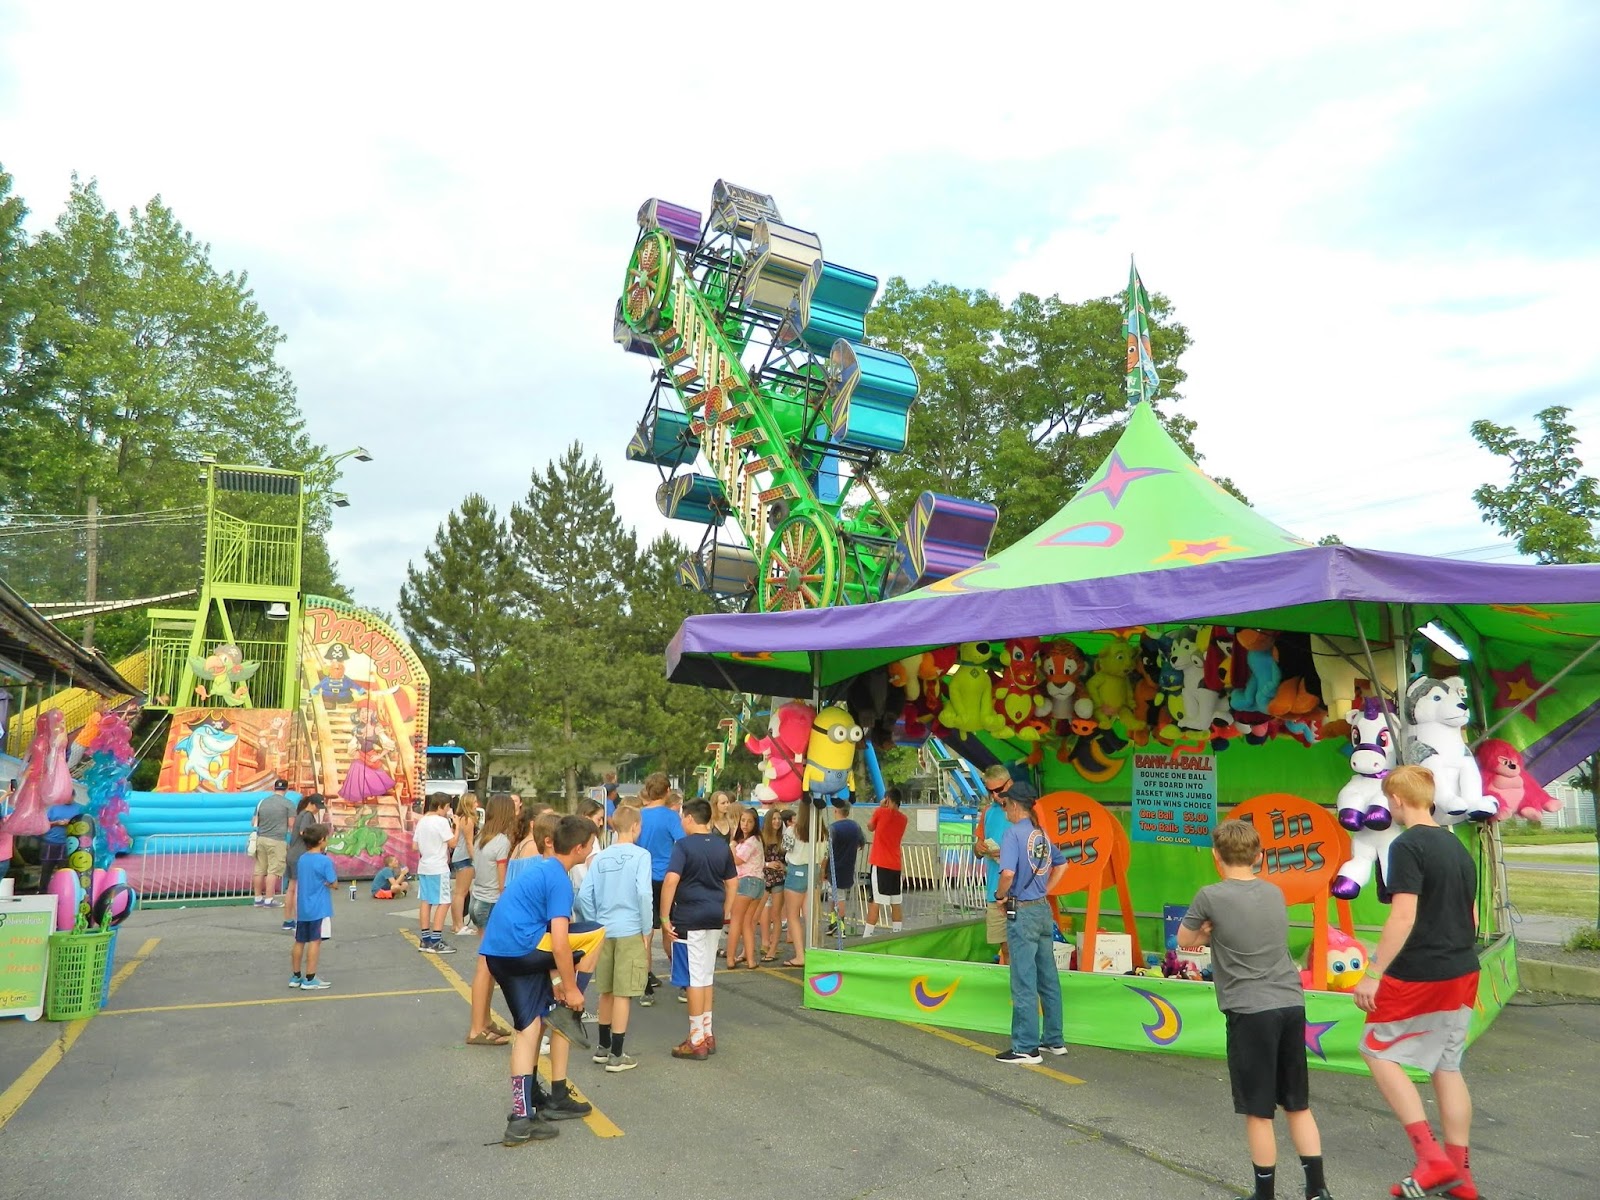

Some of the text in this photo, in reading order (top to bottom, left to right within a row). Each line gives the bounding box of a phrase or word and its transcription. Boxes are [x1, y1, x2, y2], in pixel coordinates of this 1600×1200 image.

[1135, 754, 1212, 771] BANK-A-BALL
[1140, 771, 1169, 779] BOUNCE
[1171, 772, 1186, 780] ONE
[1136, 789, 1164, 797] BASKET
[1185, 792, 1212, 800] JUMBO
[1136, 798, 1152, 806] TWO
[1163, 800, 1182, 808] WINS
[1183, 801, 1212, 809] CHOICE
[1140, 809, 1208, 822] One Ball $3.00
[1139, 821, 1208, 835] Two Balls $5.00
